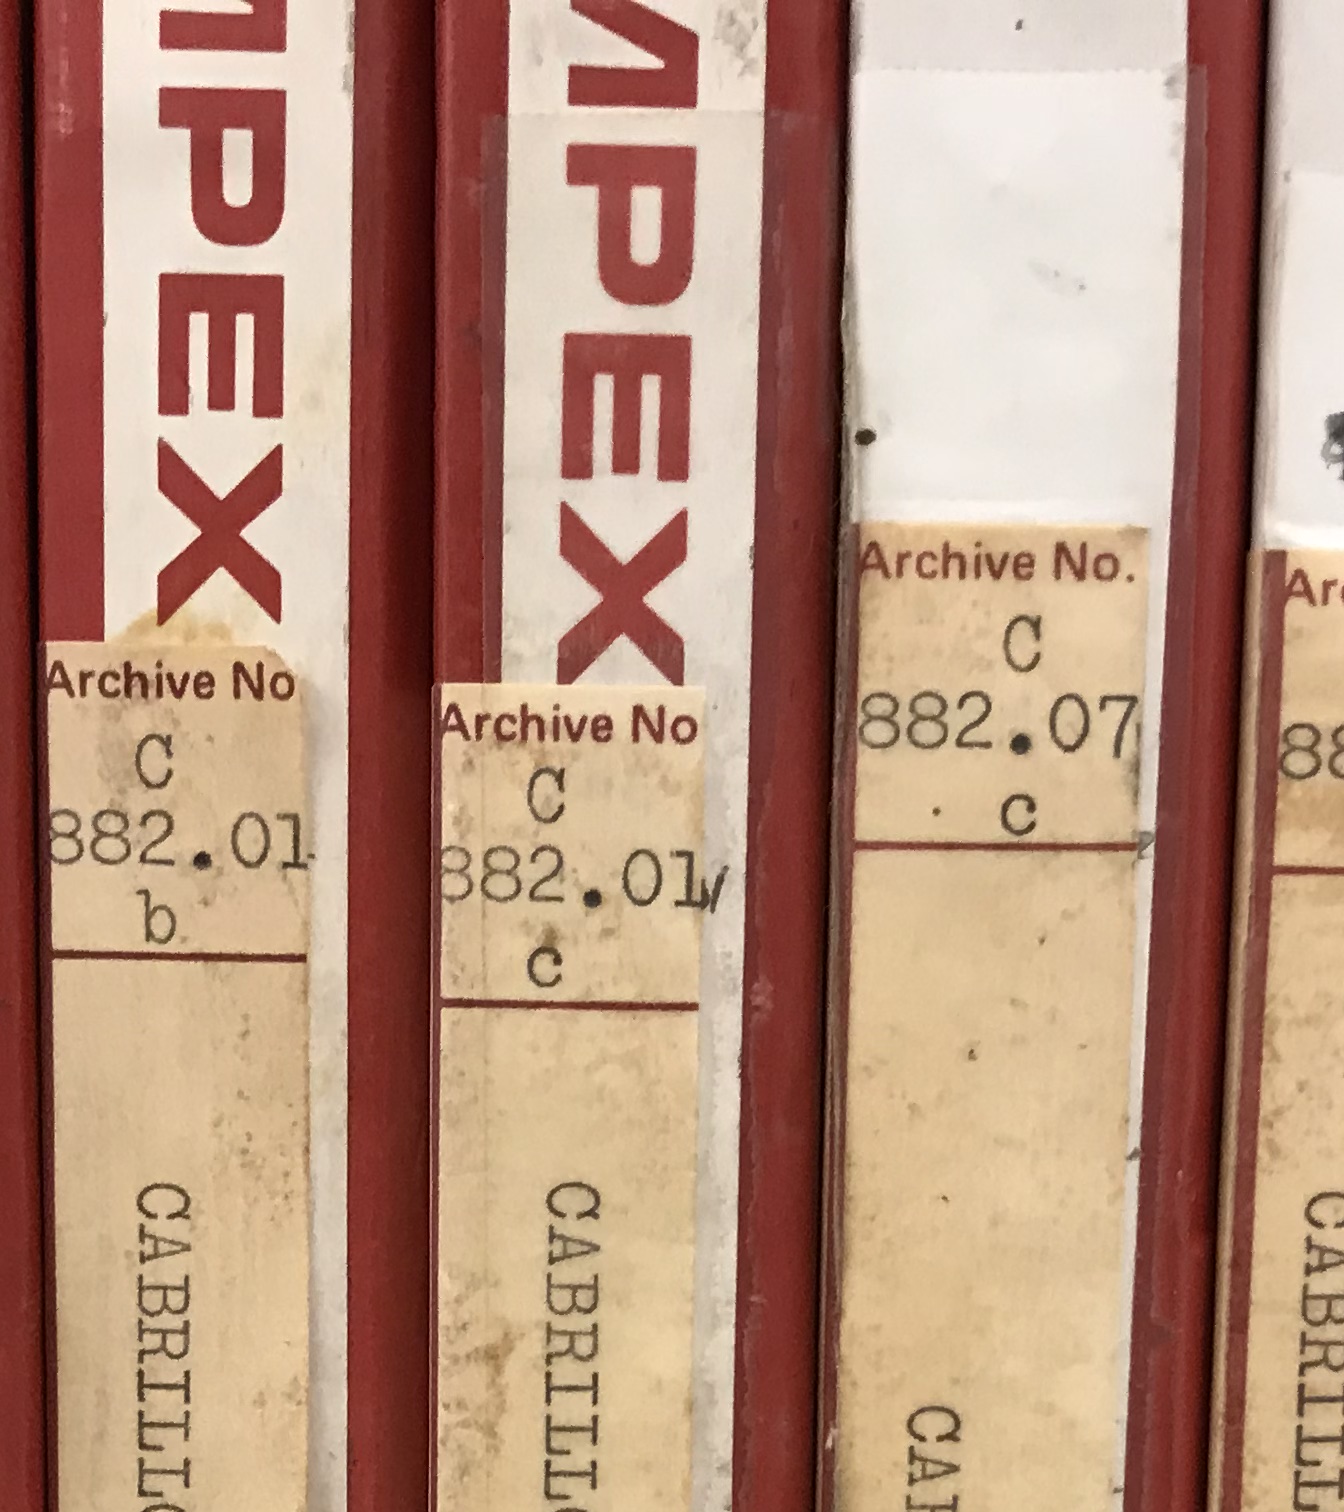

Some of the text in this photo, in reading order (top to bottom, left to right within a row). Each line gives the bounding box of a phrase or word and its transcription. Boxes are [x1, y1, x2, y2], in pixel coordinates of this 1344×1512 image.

[156, 0, 288, 627] PEX
[860, 540, 1136, 584] Archive No.
[1003, 613, 1044, 674] C
[47, 659, 297, 703] Archive No
[440, 702, 700, 747] Archive No
[858, 692, 1140, 760] 882.07
[135, 733, 175, 791] C
[527, 767, 567, 824] C
[49, 808, 311, 872] 882.01
[136, 889, 178, 945] b
